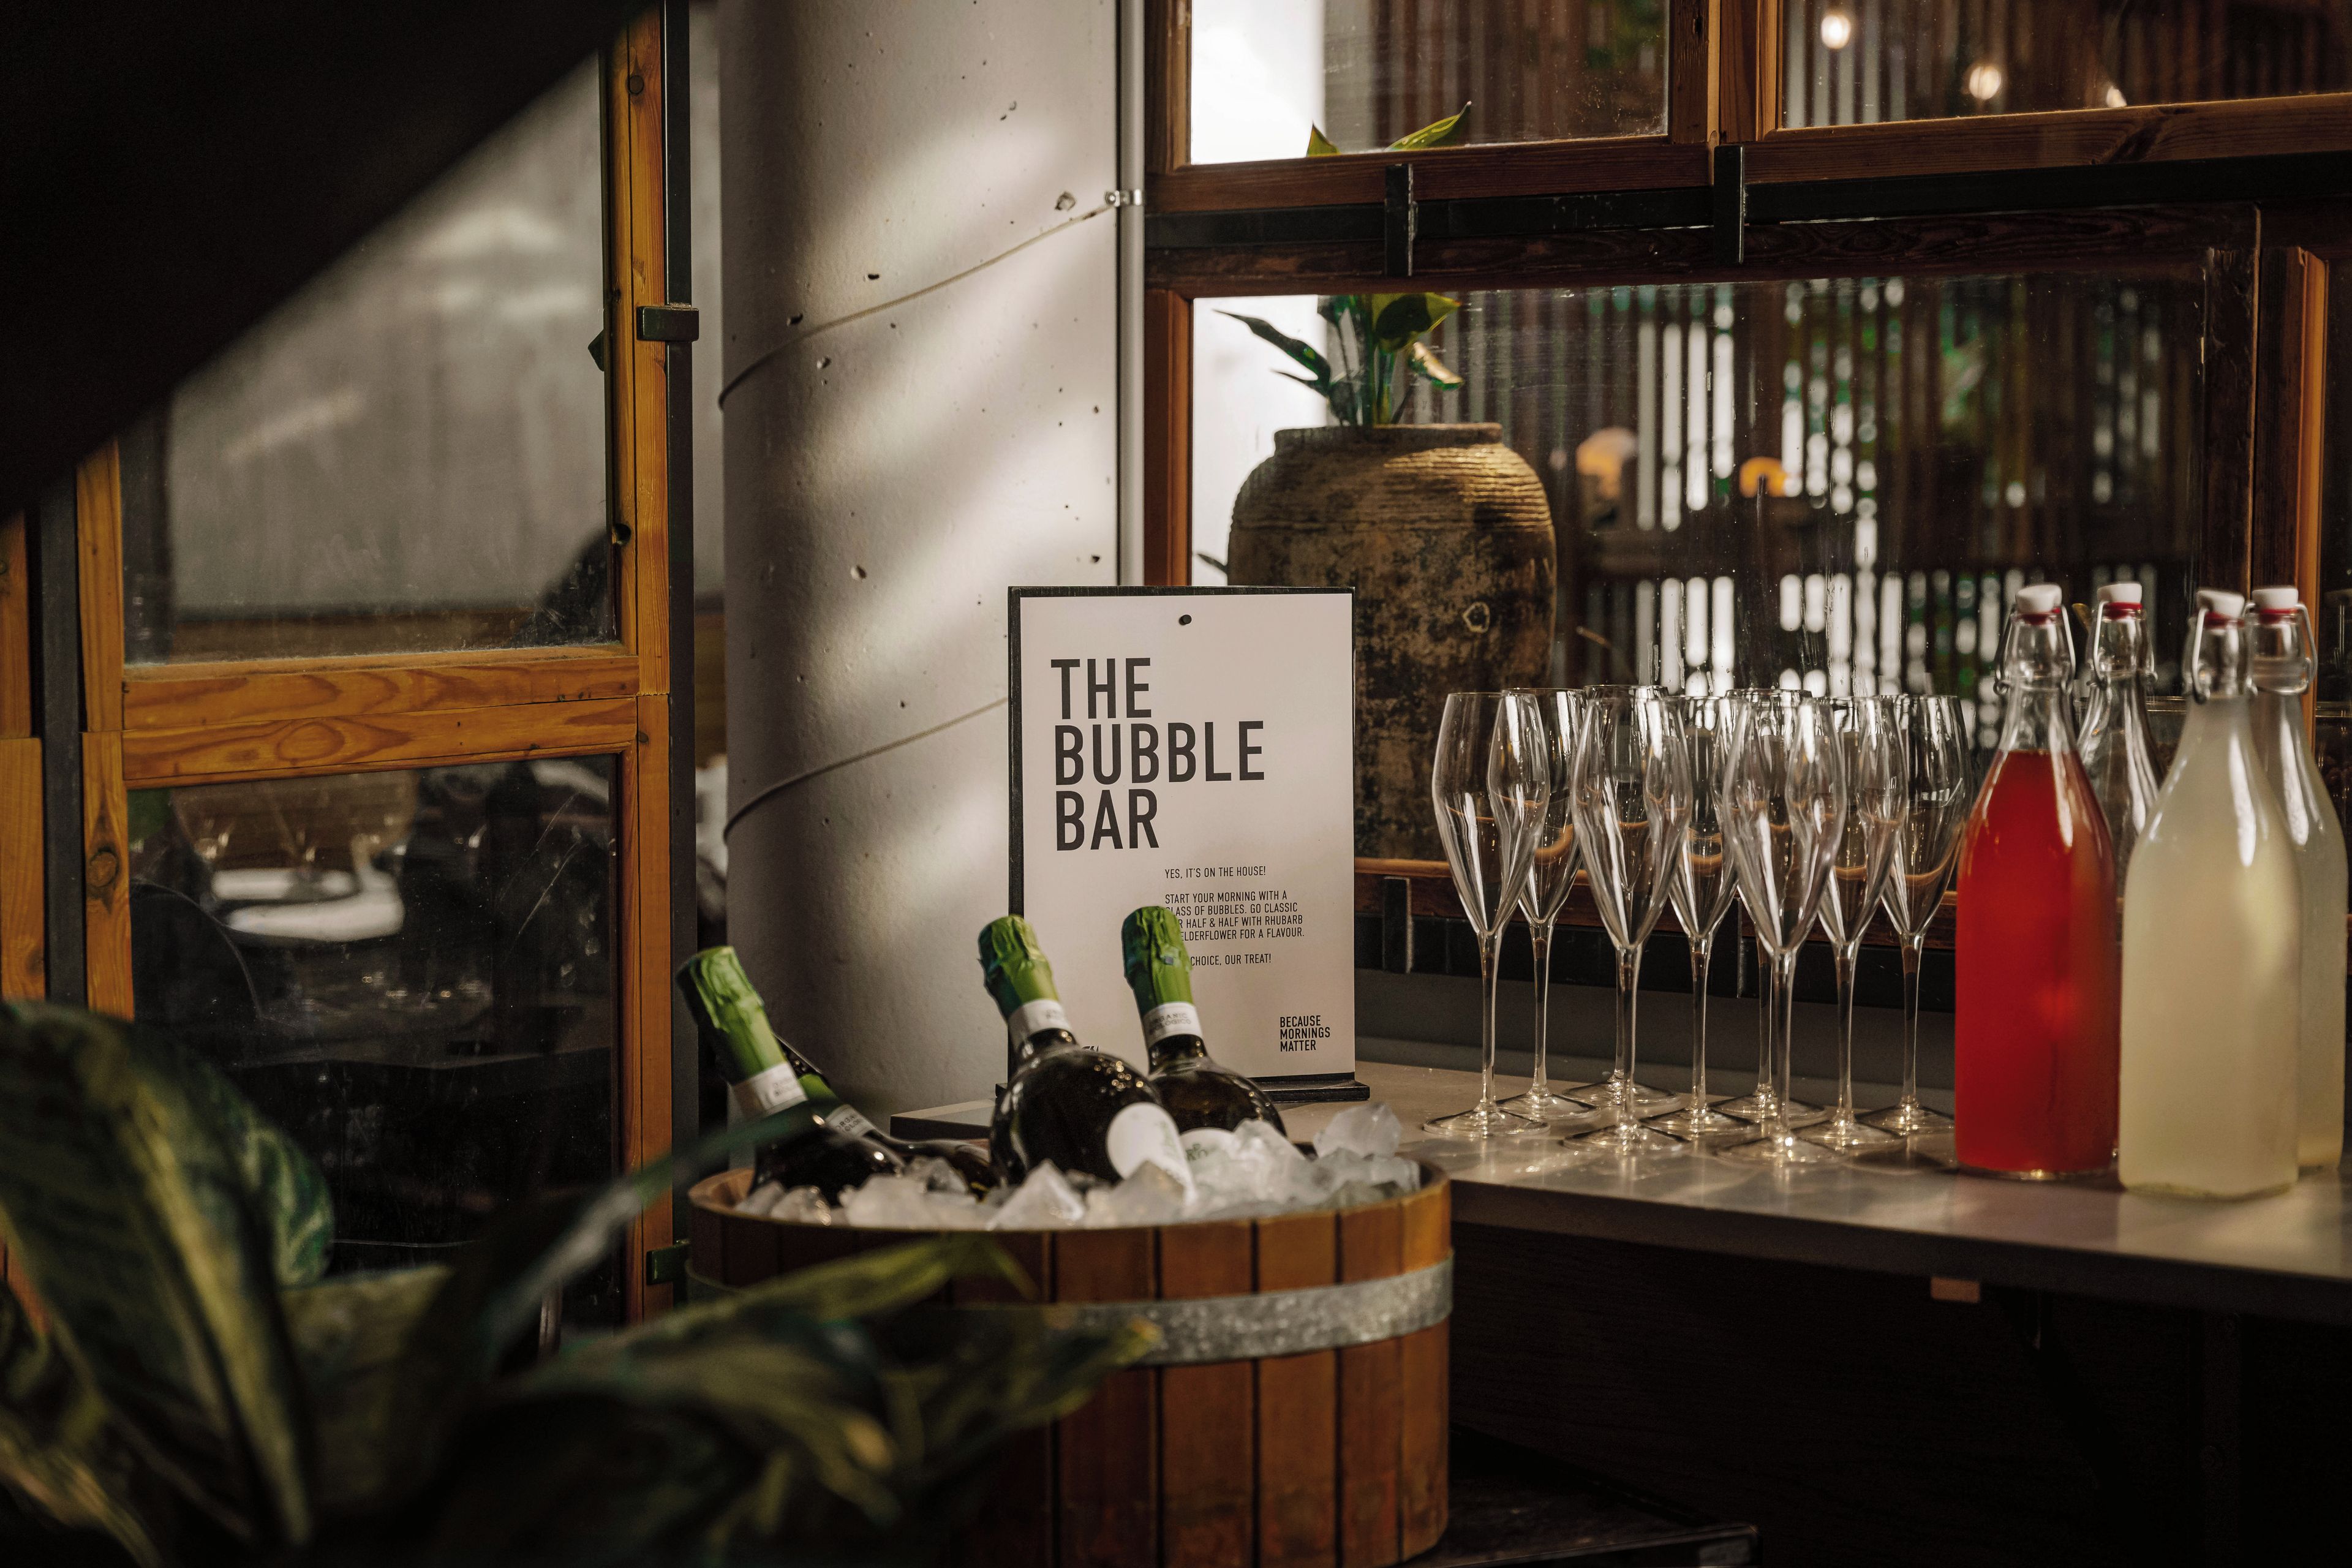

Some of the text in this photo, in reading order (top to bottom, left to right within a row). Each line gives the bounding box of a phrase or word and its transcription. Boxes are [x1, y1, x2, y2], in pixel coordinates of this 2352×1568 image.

[1050, 657, 1152, 720] THE
[1055, 720, 1265, 786] BUBBLE
[1056, 789, 1159, 851] BAR
[1165, 865, 1266, 879] YES, IT'S ON THE HOUSE!
[1165, 890, 1287, 904] START YOUR MORNING WITH A
[1194, 905, 1205, 915] OF
[1208, 904, 1247, 915] BUBBLES.
[1250, 903, 1261, 913] GO
[1264, 902, 1298, 913] CLASSIC
[1186, 918, 1207, 929] HALF
[1209, 918, 1215, 927] &
[1218, 917, 1238, 927] HALF
[1241, 916, 1262, 926] WITH
[1265, 914, 1303, 925] RHUBARB
[1240, 929, 1256, 939] FOR
[1258, 929, 1264, 938] A
[1267, 927, 1305, 938] FLAVOUR.
[1190, 954, 1272, 966] CHOICE, OUR TREAT!
[1280, 1015, 1322, 1028] BECAUSE
[1280, 1027, 1330, 1040] MORNINGS
[1280, 1039, 1317, 1052] MATTER
